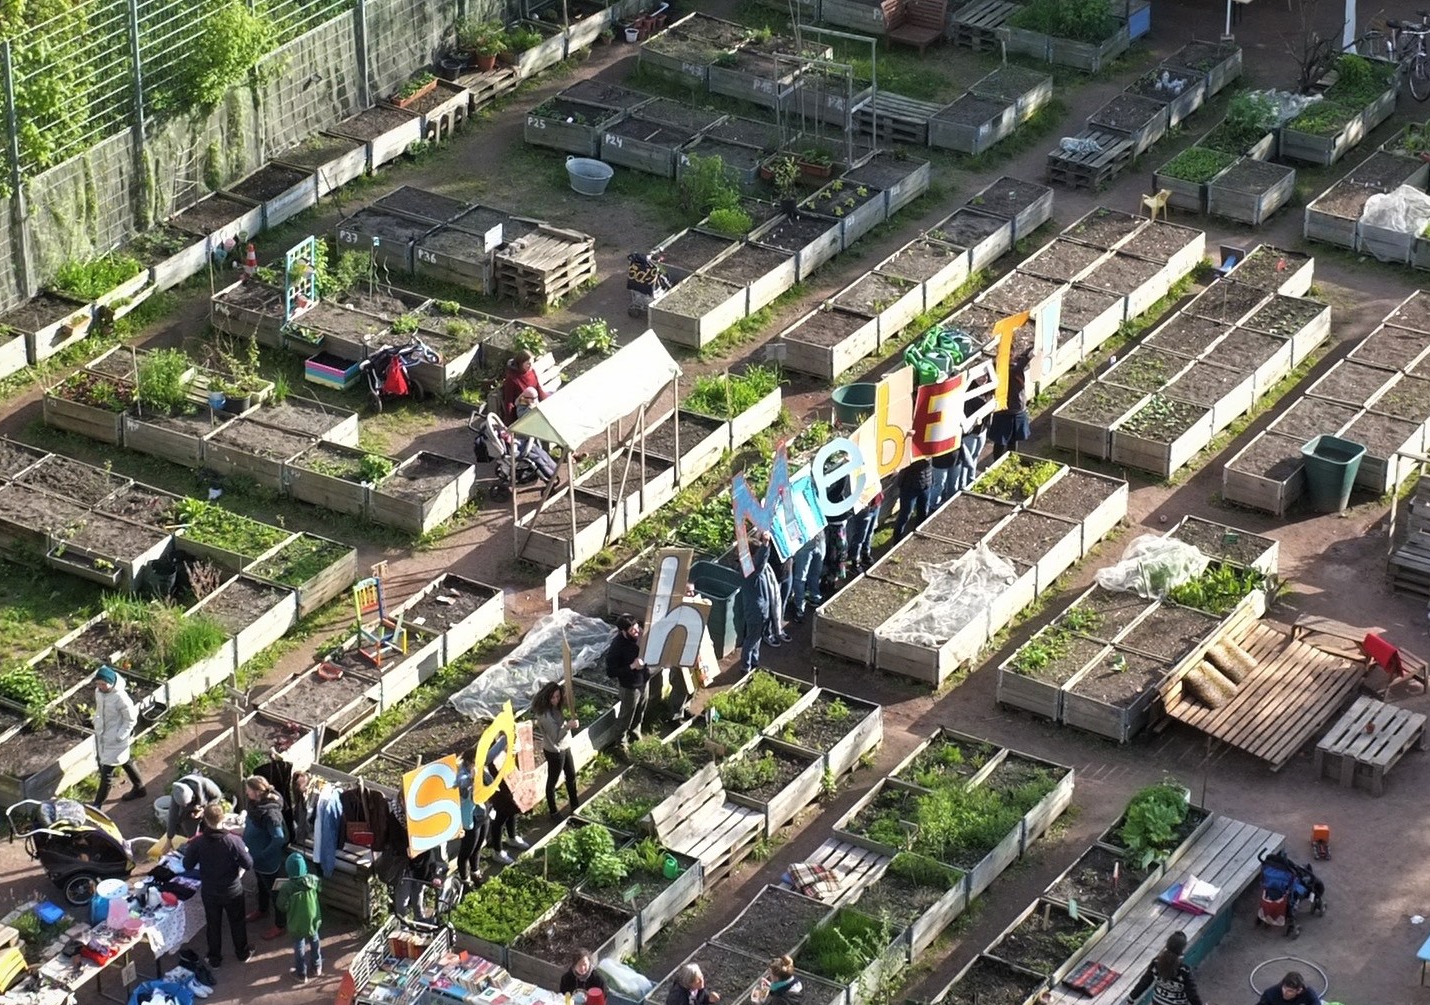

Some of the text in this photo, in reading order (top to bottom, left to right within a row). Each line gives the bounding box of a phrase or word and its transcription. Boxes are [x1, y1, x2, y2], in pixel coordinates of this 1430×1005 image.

[527, 116, 546, 129] P25
[605, 133, 623, 148] P24
[339, 230, 358, 244] P37
[418, 249, 437, 264] P36
